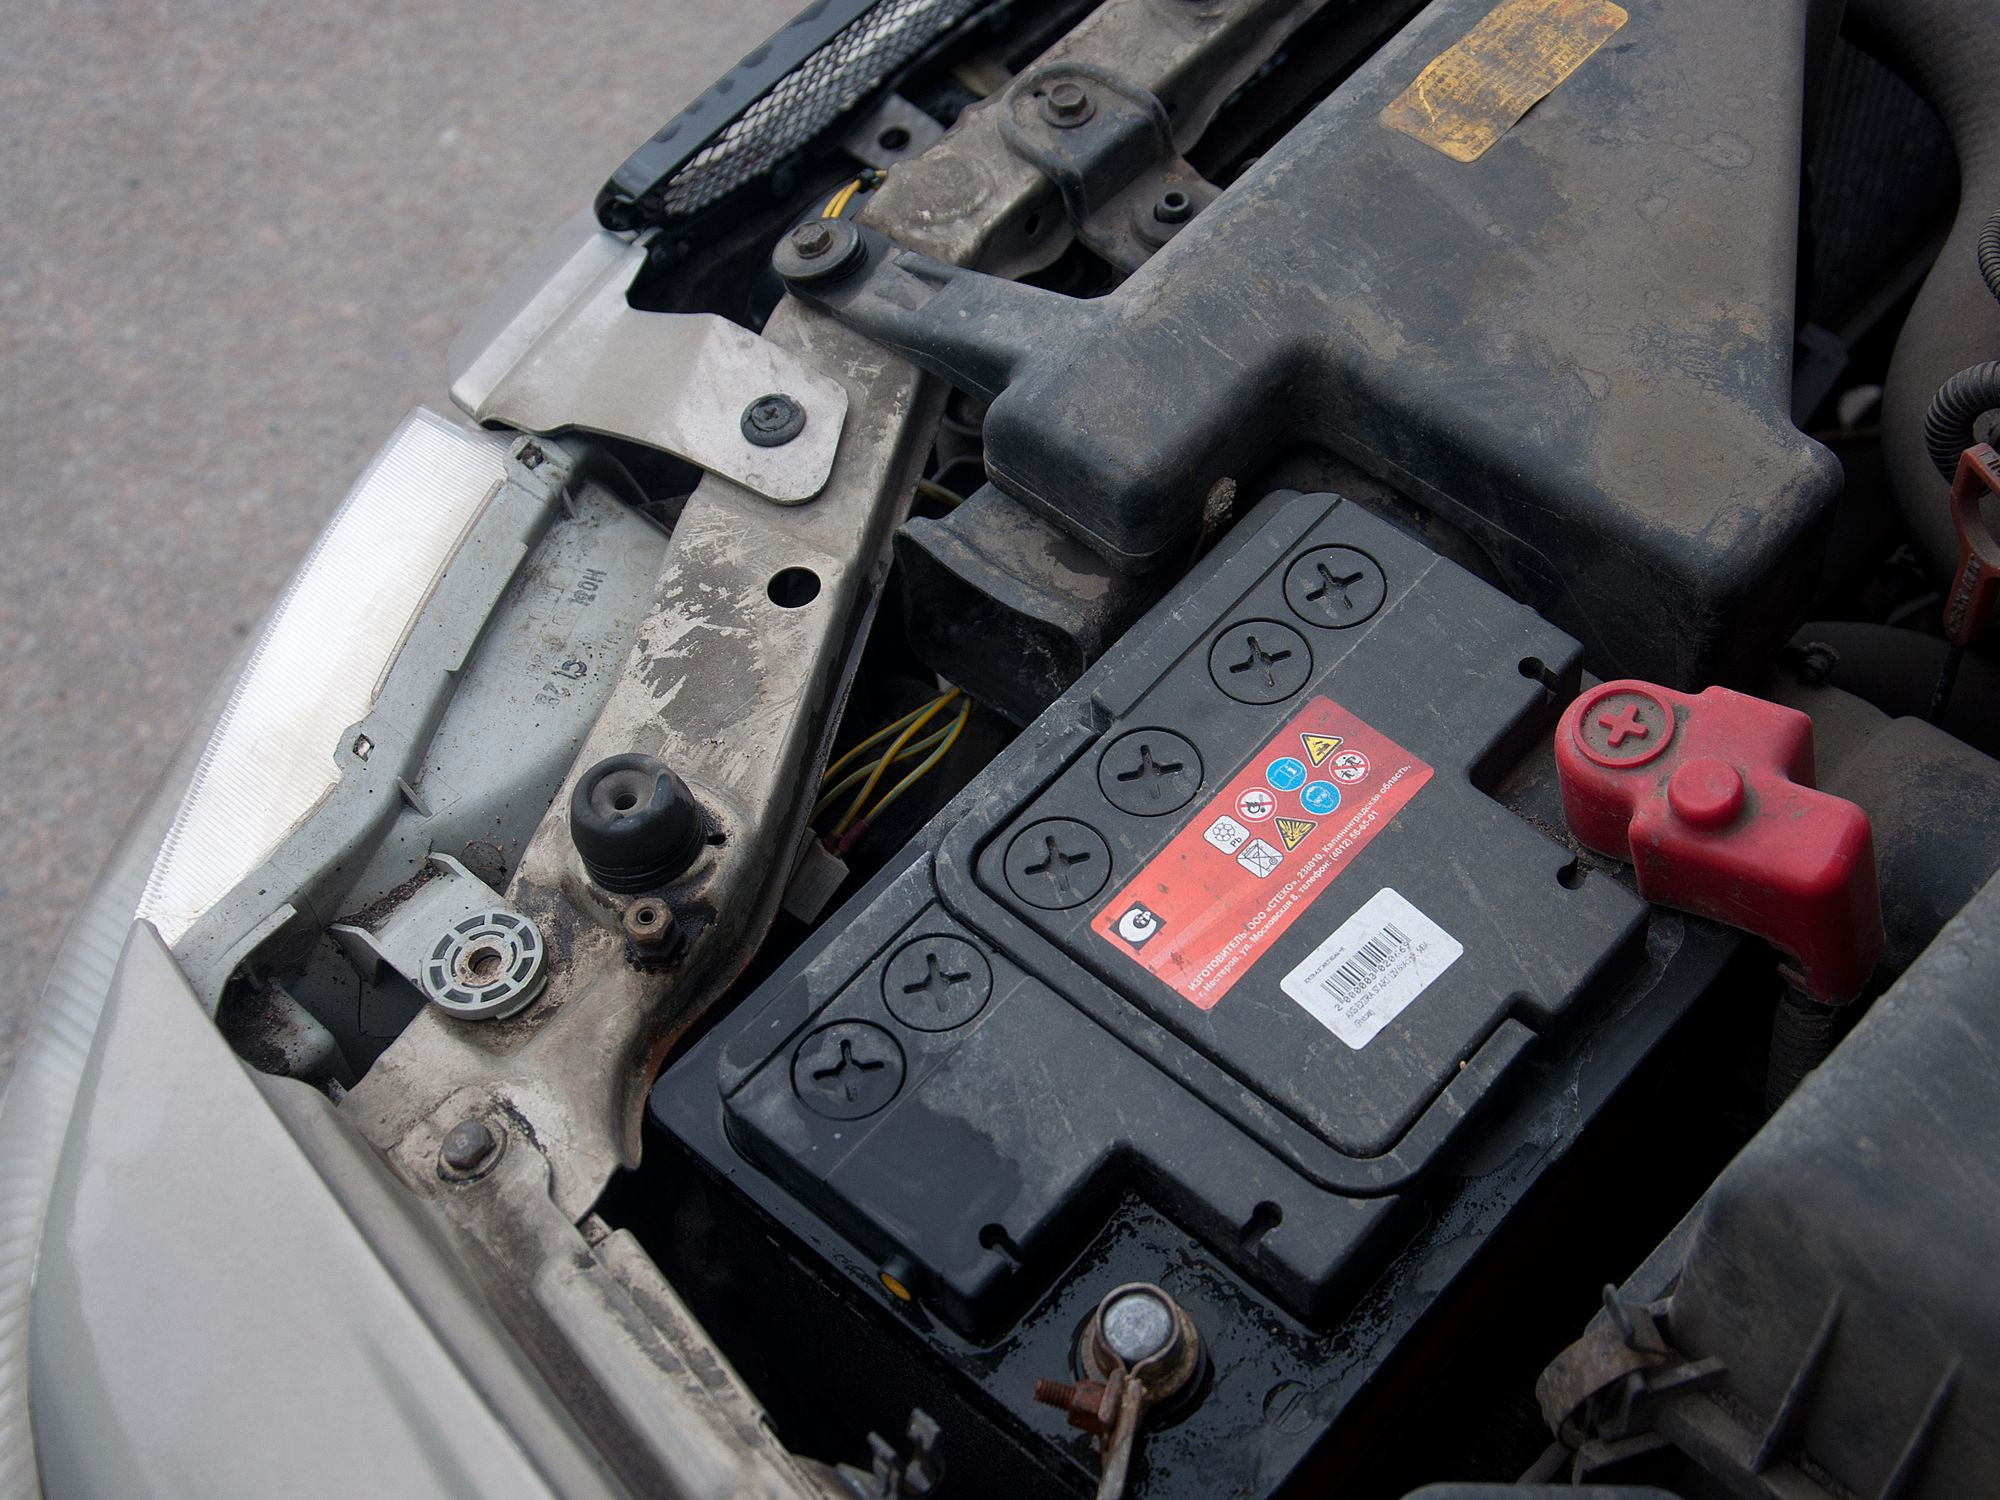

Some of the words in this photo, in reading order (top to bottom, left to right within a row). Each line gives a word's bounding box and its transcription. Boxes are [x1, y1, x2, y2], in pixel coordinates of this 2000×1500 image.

[1187, 929, 1251, 991] ИЗГОТОВИТЕЛЬ:
[1247, 911, 1267, 930] ООО
[1322, 793, 1382, 853] Калининградская
[1380, 765, 1412, 794] область,
[1229, 836, 1243, 848] Pb
[1239, 943, 1252, 956] ул.
[1249, 899, 1294, 943] Московская
[1298, 860, 1332, 893] телефон:
[1329, 839, 1354, 861] (4012)
